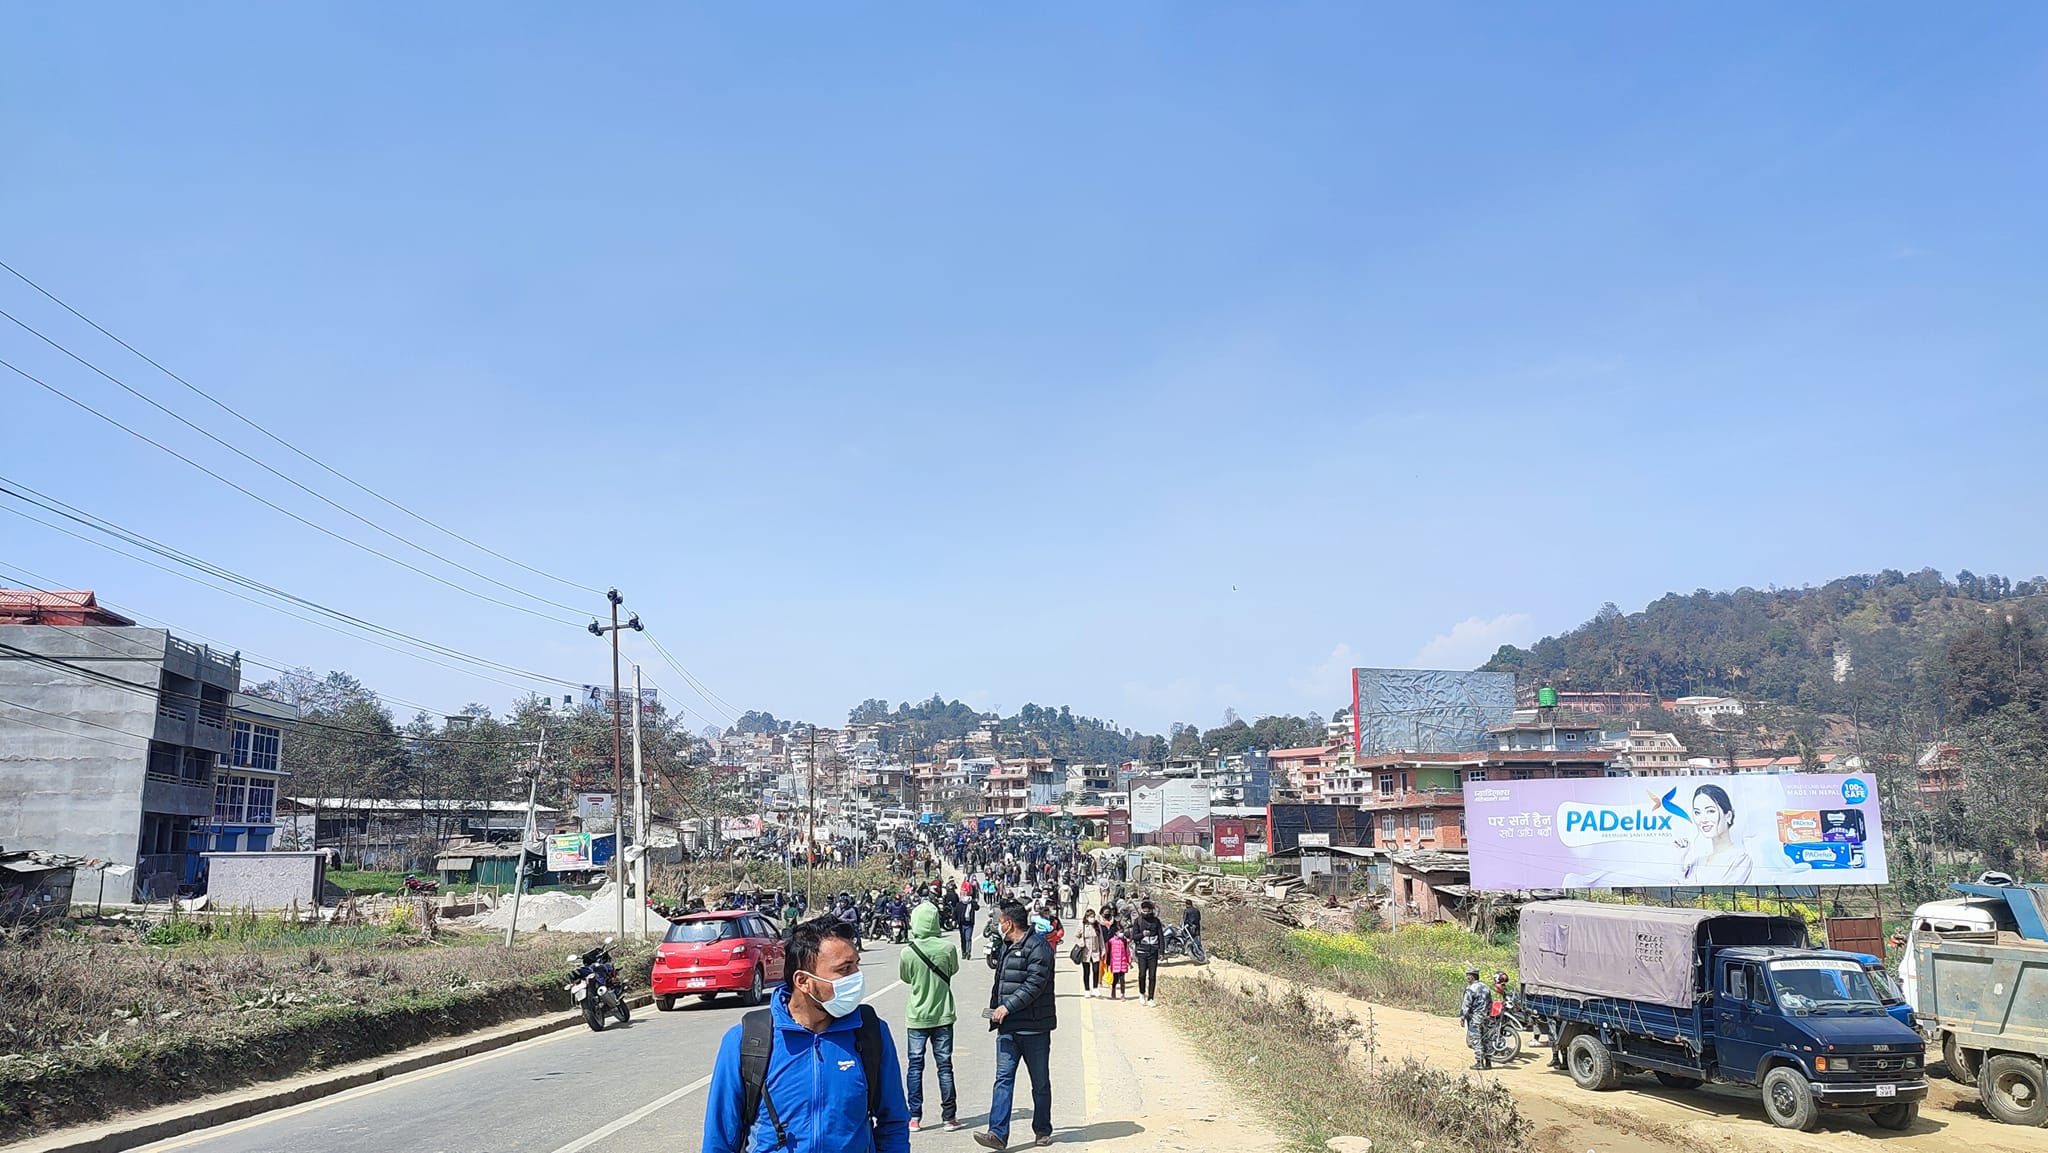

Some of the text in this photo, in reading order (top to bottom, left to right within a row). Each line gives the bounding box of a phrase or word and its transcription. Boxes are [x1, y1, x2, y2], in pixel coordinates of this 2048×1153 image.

[1844, 790, 1865, 799] SAFE
[1488, 815, 1505, 826] पर
[1566, 809, 1673, 832] PADelux
[1872, 1044, 1889, 1052] TATA
